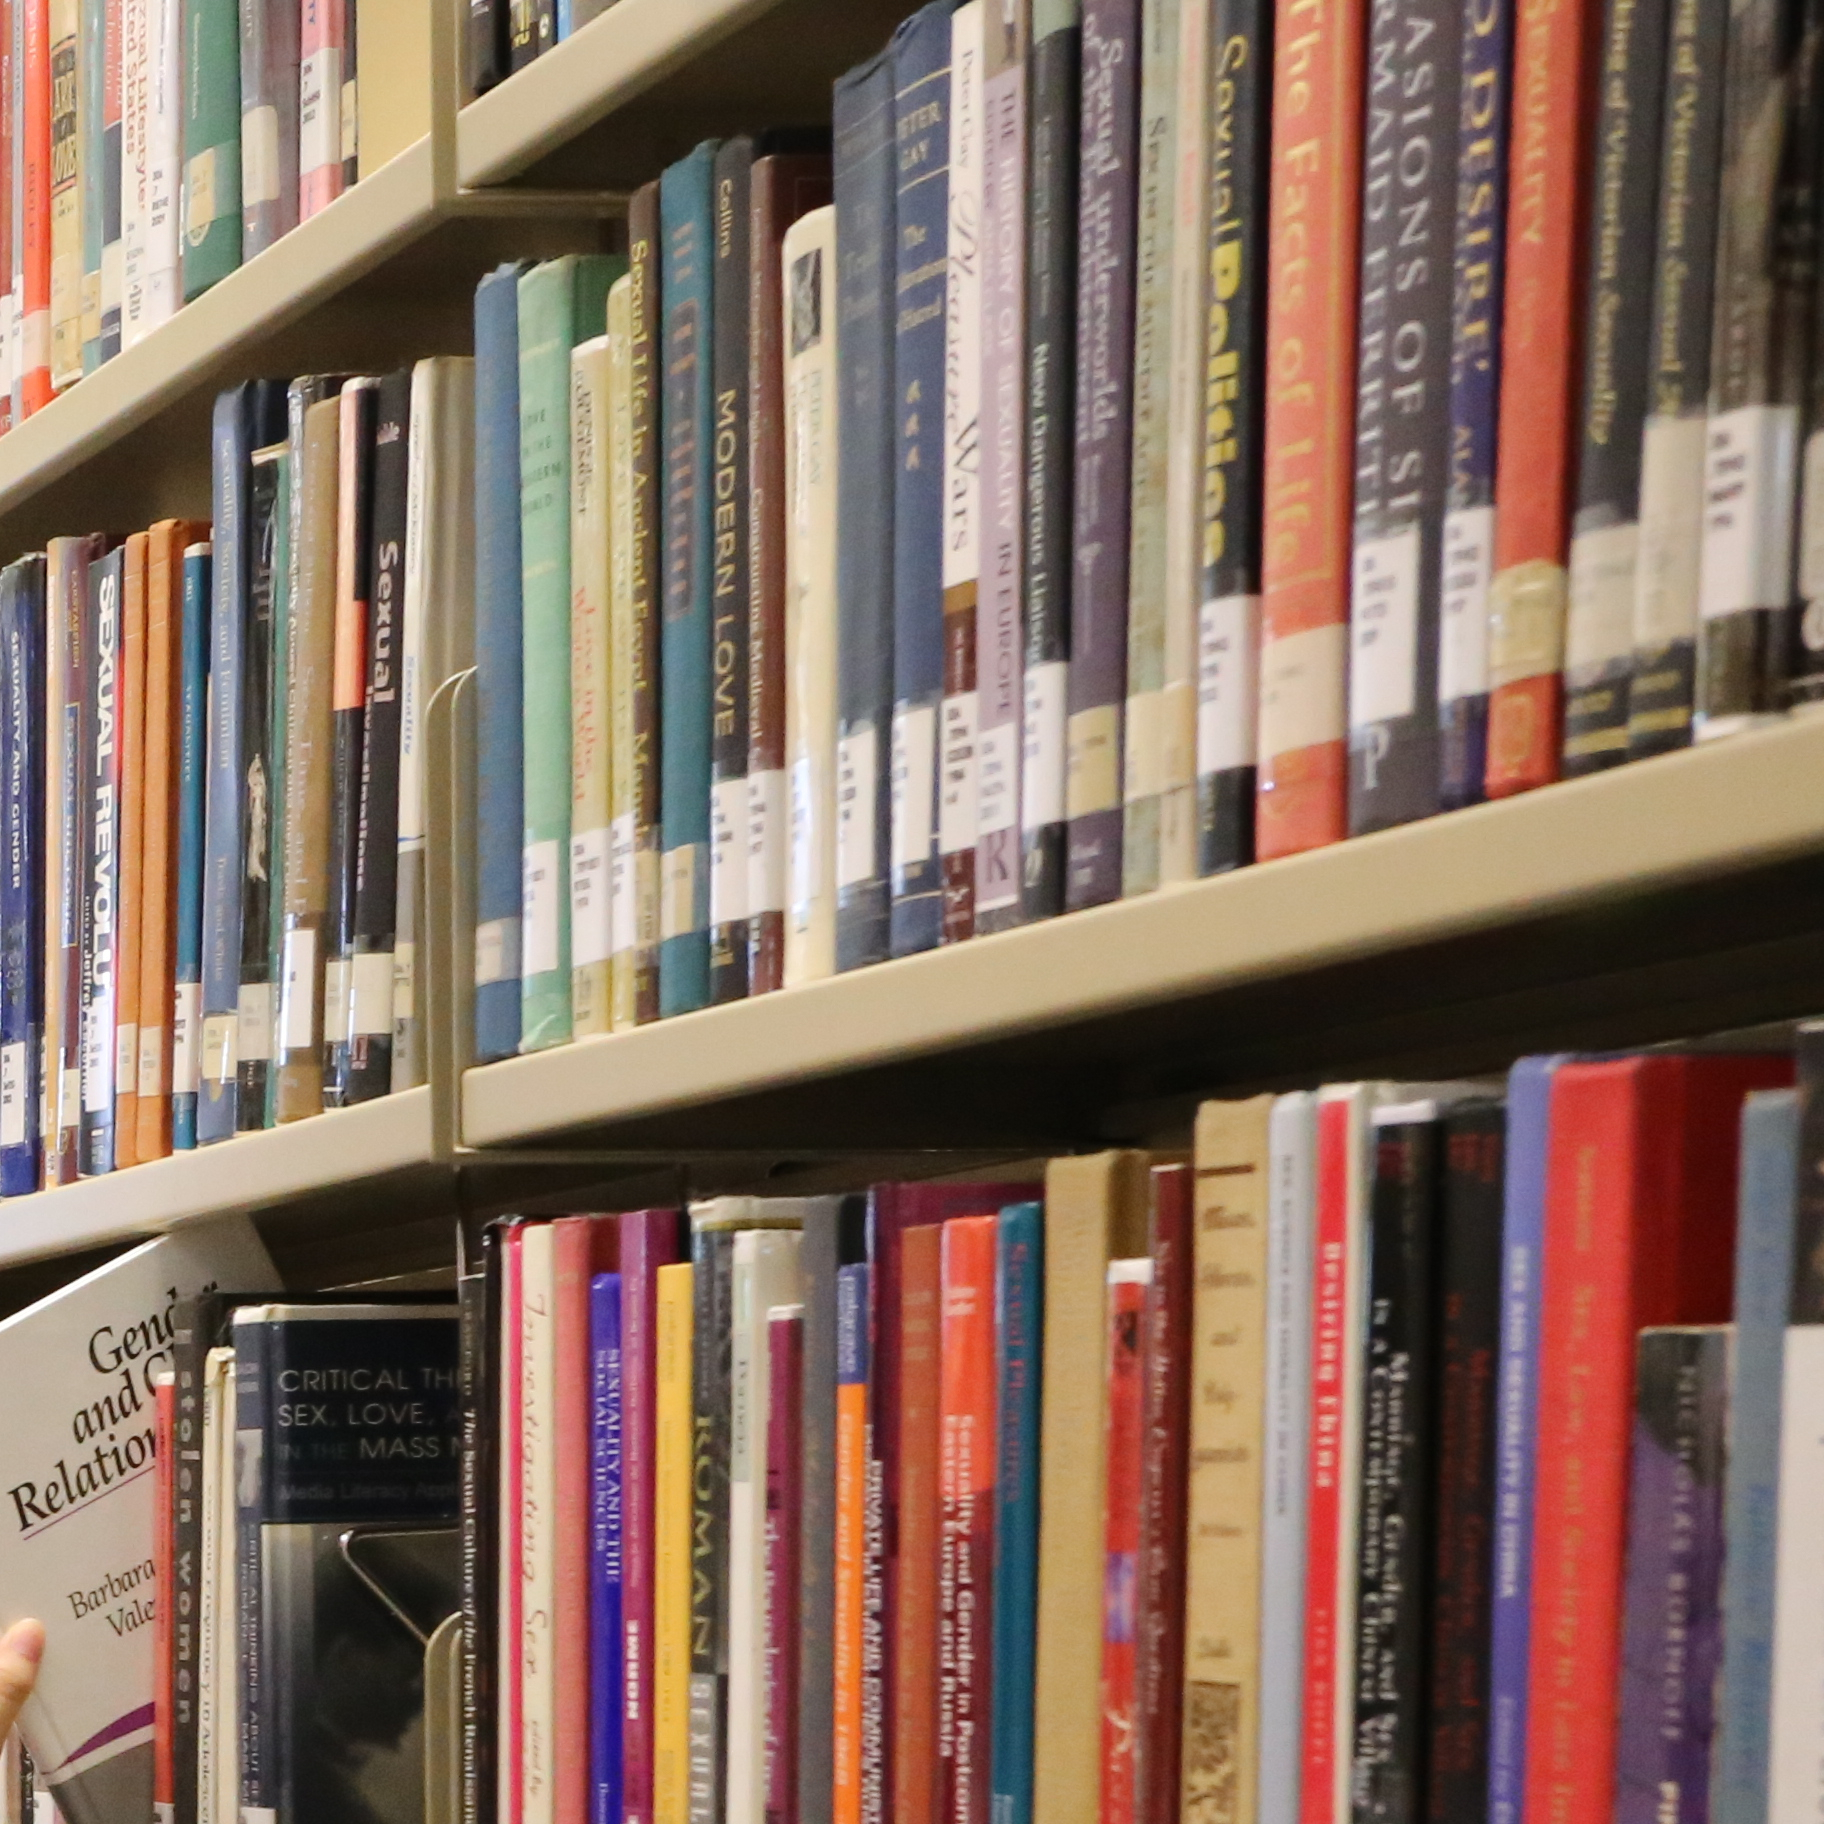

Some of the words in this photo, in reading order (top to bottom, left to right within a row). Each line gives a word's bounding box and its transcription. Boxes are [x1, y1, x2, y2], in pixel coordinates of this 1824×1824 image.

[960, 50, 975, 111] Peter
[1096, 38, 1125, 176] Sexual
[958, 116, 973, 168] Gay
[719, 178, 734, 258] Collins
[997, 157, 1017, 293] HISTORY
[1281, 137, 1322, 312] Facts
[1599, 118, 1630, 280] Victorian
[631, 239, 650, 347] Sexual
[1092, 192, 1121, 441] underworlds
[1033, 343, 1049, 408] New
[1276, 337, 1316, 404] of
[1390, 319, 1427, 414] OF
[1588, 290, 1620, 445] Sexuality
[715, 388, 737, 600] MODERN
[951, 417, 983, 552] Wars
[997, 366, 1016, 529] SEXUALITY
[1028, 416, 1048, 564] Dangerous
[1271, 437, 1316, 563] Life
[749, 486, 762, 635] Constructing
[95, 575, 120, 776] SEXUAL
[374, 542, 398, 703] Sexual
[714, 614, 736, 739] LOVE
[996, 588, 1014, 714] EUROPE
[10, 630, 20, 742] SEXUALITY
[218, 669, 232, 770] Feminism
[403, 655, 414, 755] Sexuality
[749, 639, 763, 738] Medieval
[11, 803, 21, 889] GENDER
[94, 784, 118, 988] REVOLU
[1317, 1241, 1342, 1382] Desiring
[73, 1369, 143, 1445] and
[277, 1368, 410, 1393] CRITICAL
[595, 1348, 607, 1429] SOCIAL
[606, 1347, 621, 1476] SEXUALITY
[179, 1370, 201, 1525] stolen
[359, 1436, 442, 1460] MASS
[463, 1449, 477, 1513] Sexual
[521, 1294, 550, 1583] Investigating
[595, 1435, 607, 1552] SCIENCES
[941, 1415, 959, 1512] Eastern
[954, 1415, 977, 1536] Sexuality
[1669, 1363, 1699, 1555] NICHOLAS
[463, 1518, 477, 1594] Culture
[606, 1479, 621, 1532] AND
[693, 1416, 714, 1657] ROMAN
[868, 1459, 884, 1557] PRIVATE
[939, 1519, 957, 1613] Europe
[957, 1541, 974, 1583] and
[106, 1597, 156, 1640] Vale
[177, 1551, 194, 1726] women
[525, 1610, 550, 1676] Sex
[956, 1590, 977, 1687] Gender
[463, 1654, 477, 1718] French
[939, 1676, 957, 1757] Russia
